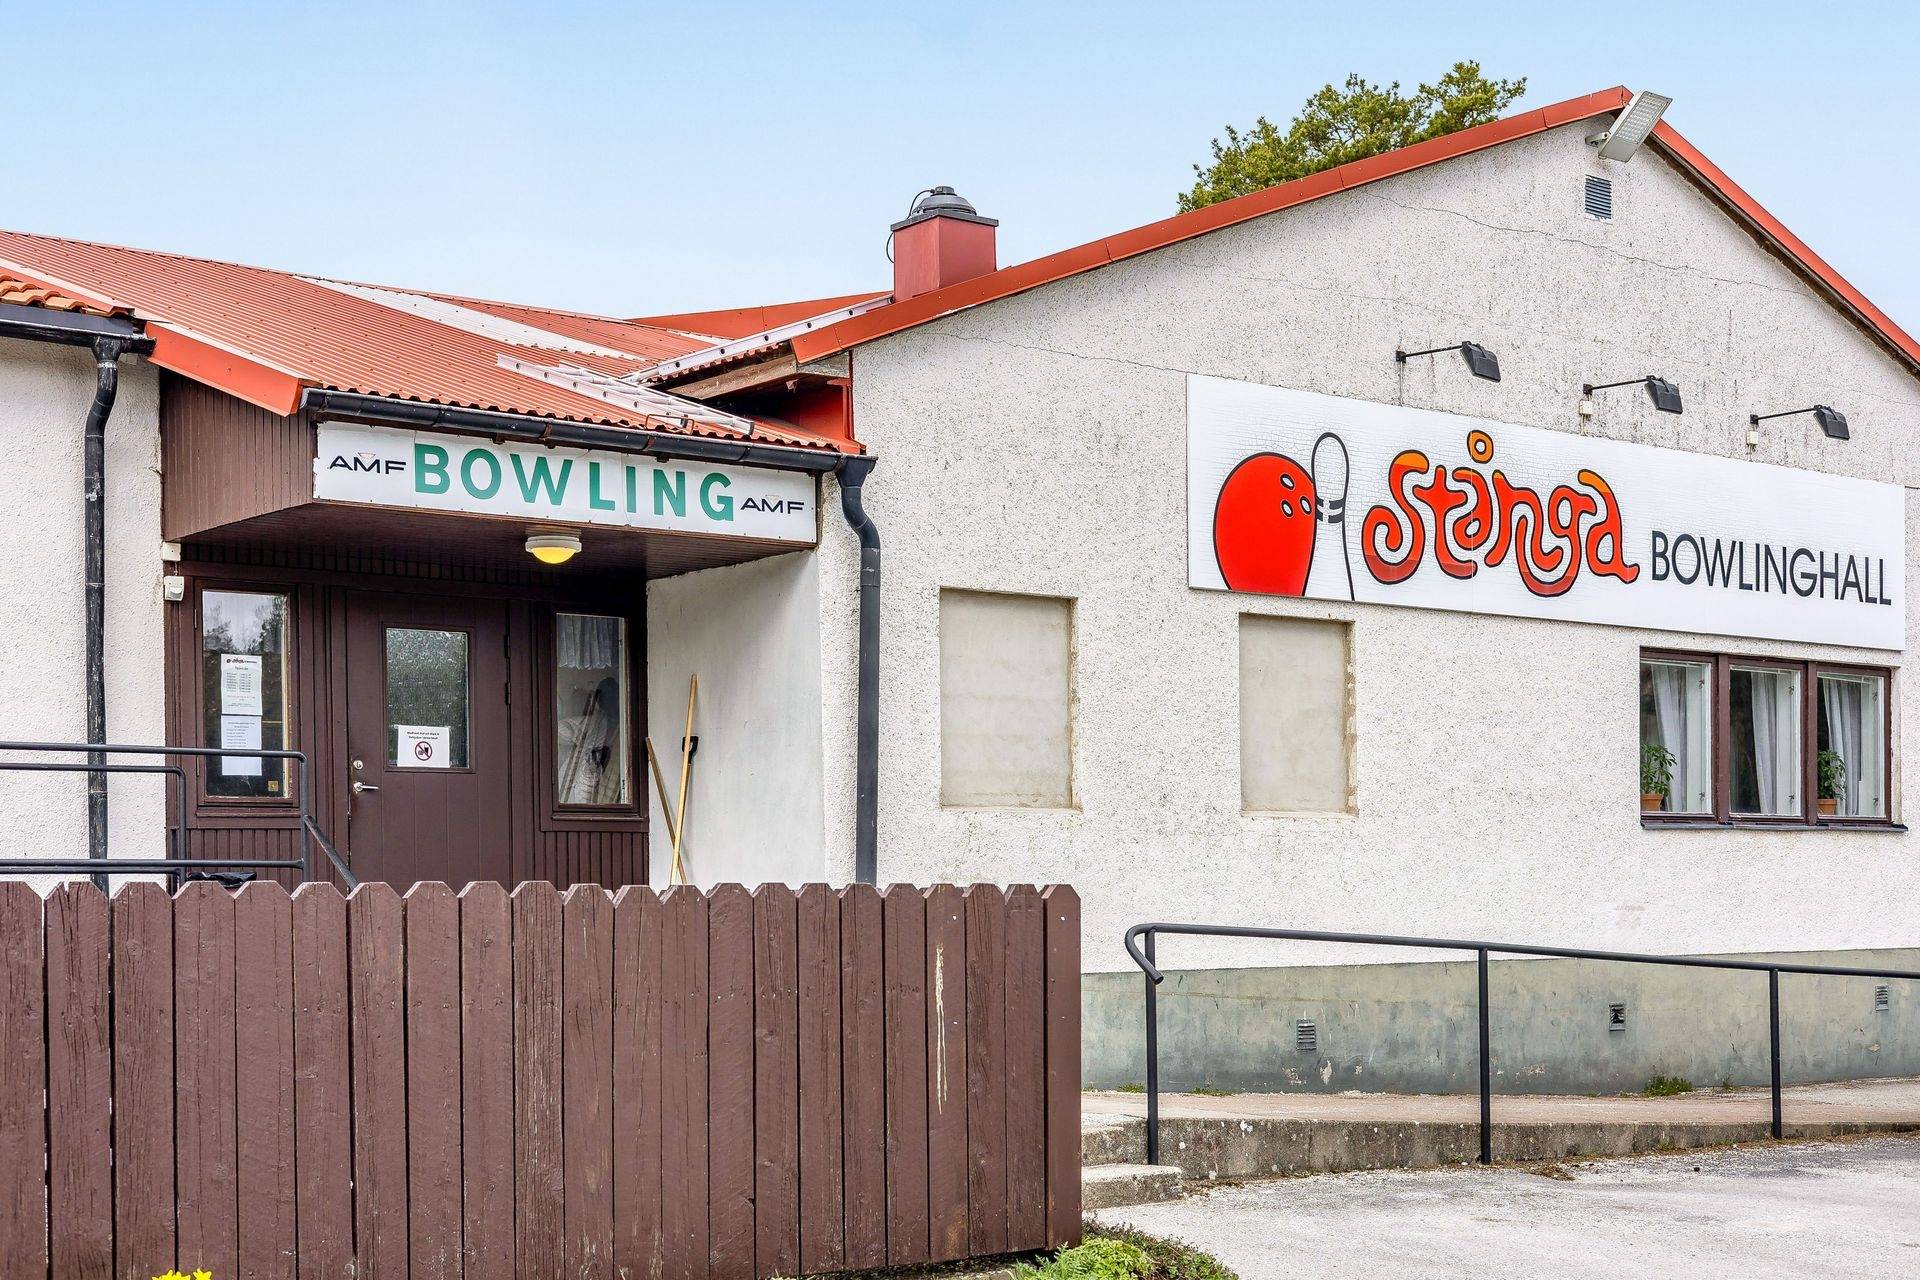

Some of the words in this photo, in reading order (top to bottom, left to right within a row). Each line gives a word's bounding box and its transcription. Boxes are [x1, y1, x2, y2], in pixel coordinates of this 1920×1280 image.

[329, 455, 407, 475] AMF
[414, 443, 734, 522] BOWLING
[740, 497, 805, 515] AMF
[1361, 429, 1640, 598] Stånga
[1651, 530, 1892, 606] BOWLINGHALL
